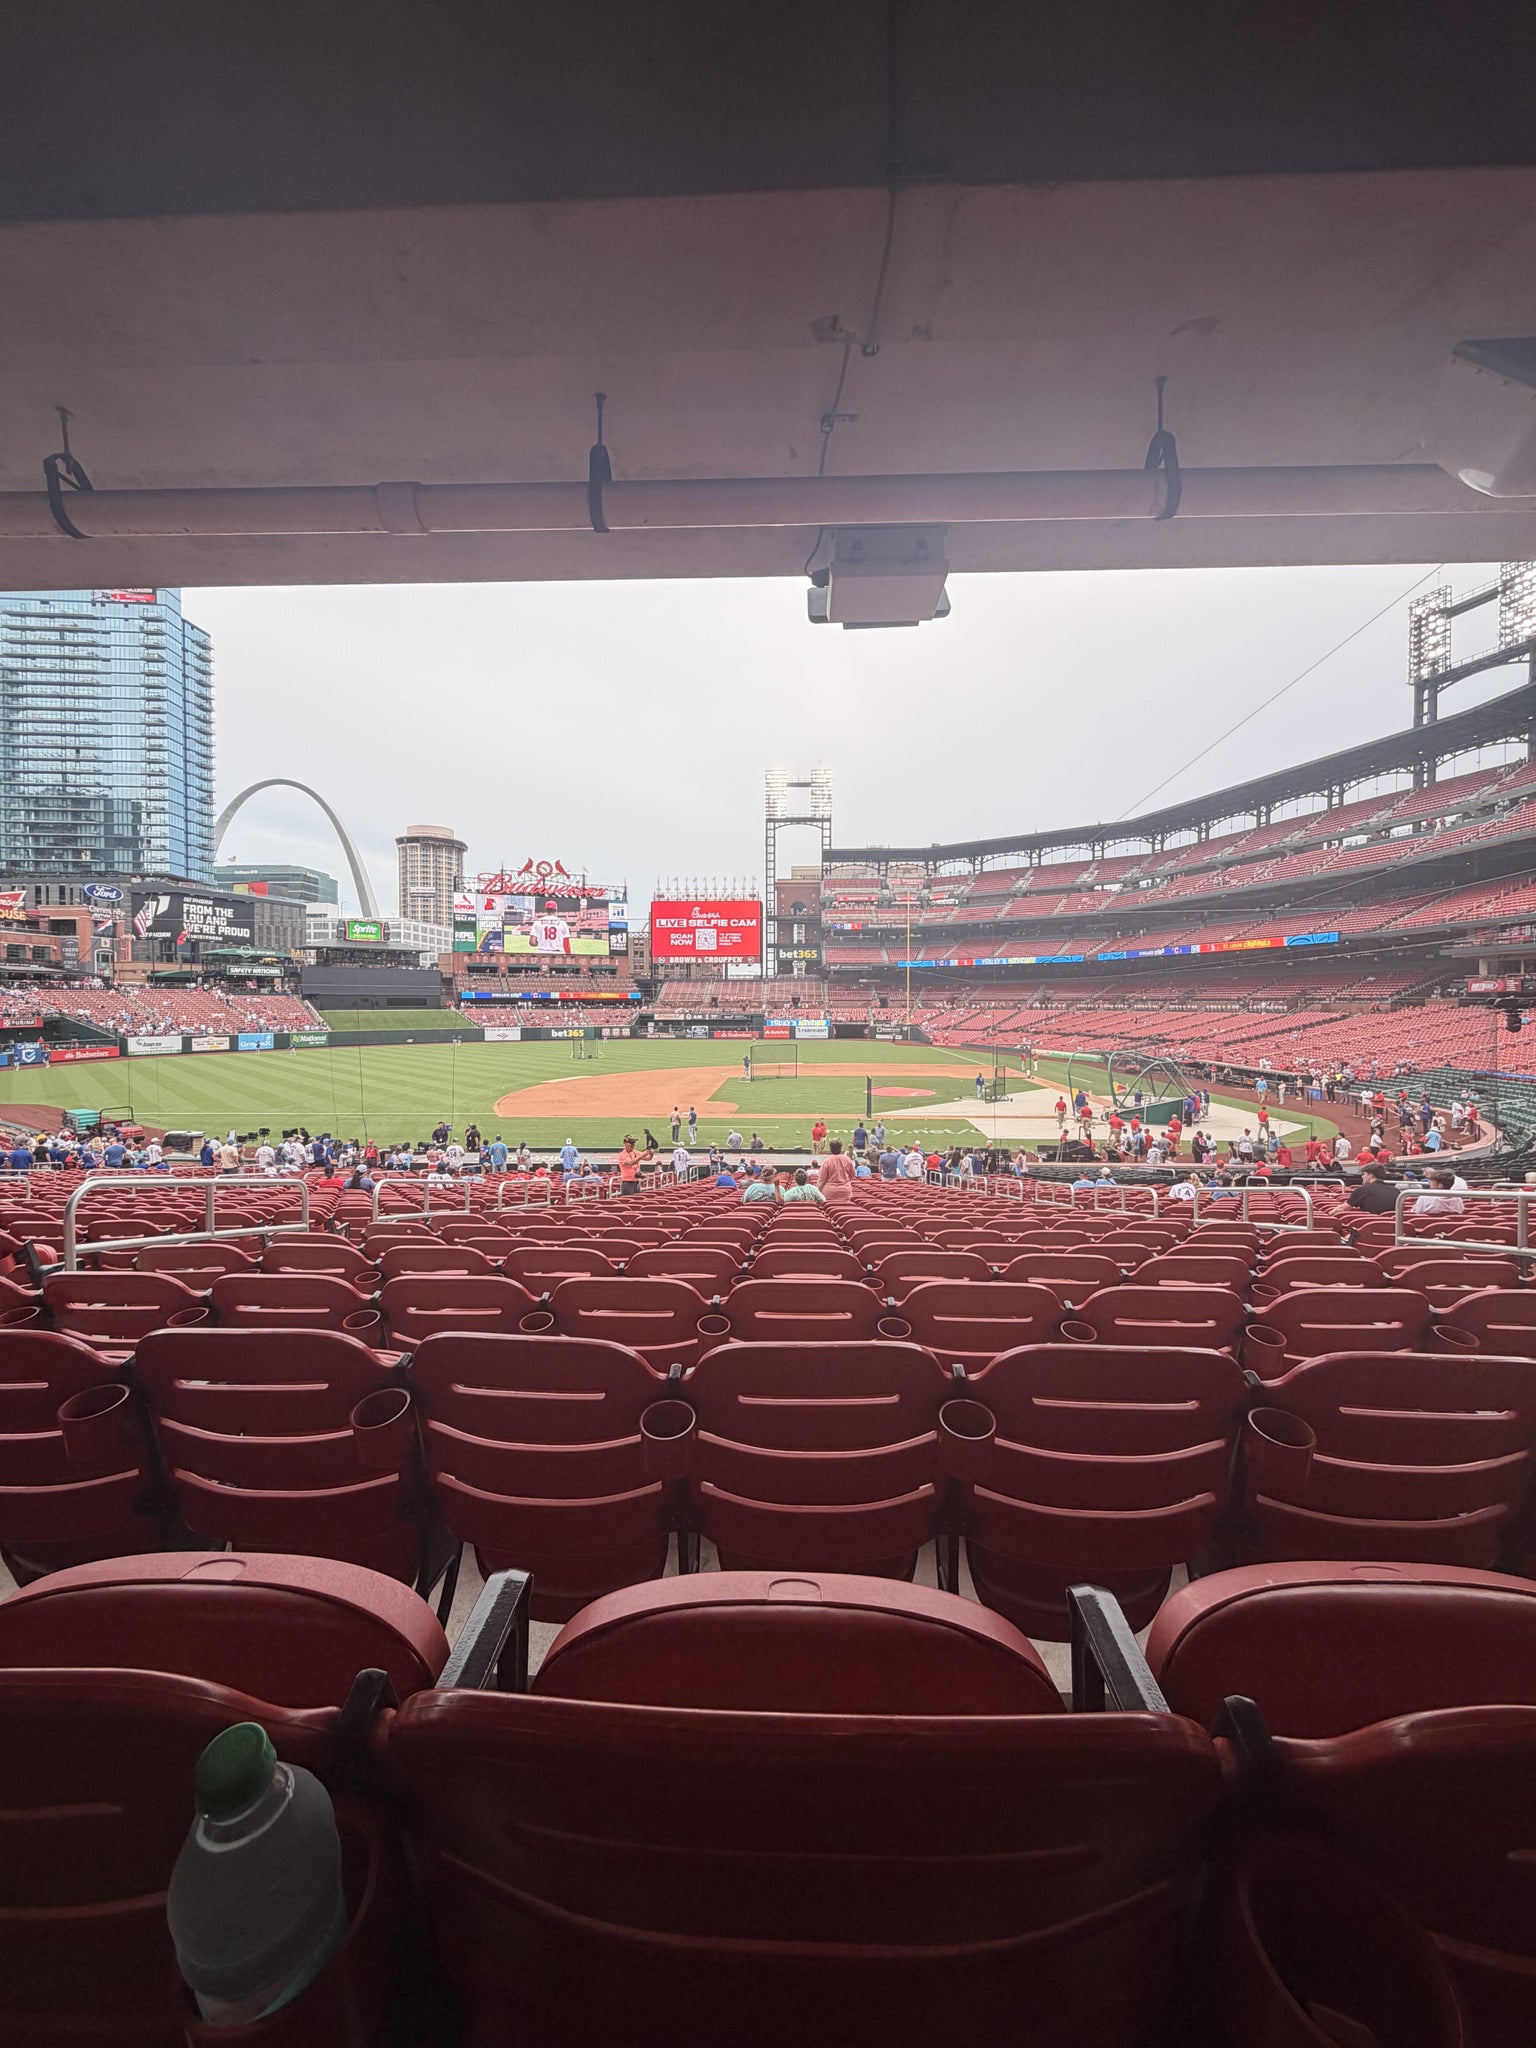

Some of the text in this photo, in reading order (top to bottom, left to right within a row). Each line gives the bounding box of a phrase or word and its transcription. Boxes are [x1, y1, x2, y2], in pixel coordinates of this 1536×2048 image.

[477, 872, 608, 898] Budweiser
[93, 885, 117, 899] Ford
[0, 908, 27, 920] OUSE
[183, 903, 235, 918] FROM THE
[183, 913, 228, 926] LOU AND
[657, 918, 757, 928] LIVE SELFIE CAM
[218, 926, 250, 938] PROUD
[353, 924, 378, 934] Sprite
[543, 925, 557, 941] 18
[454, 931, 475, 939] REPEL
[610, 932, 627, 944] stl
[779, 949, 818, 959] bet365
[230, 967, 281, 975] SAFETY NATIONAL
[300, 1034, 327, 1042] National
[551, 1029, 585, 1037] bet365
[76, 1050, 110, 1059] Budweiser
